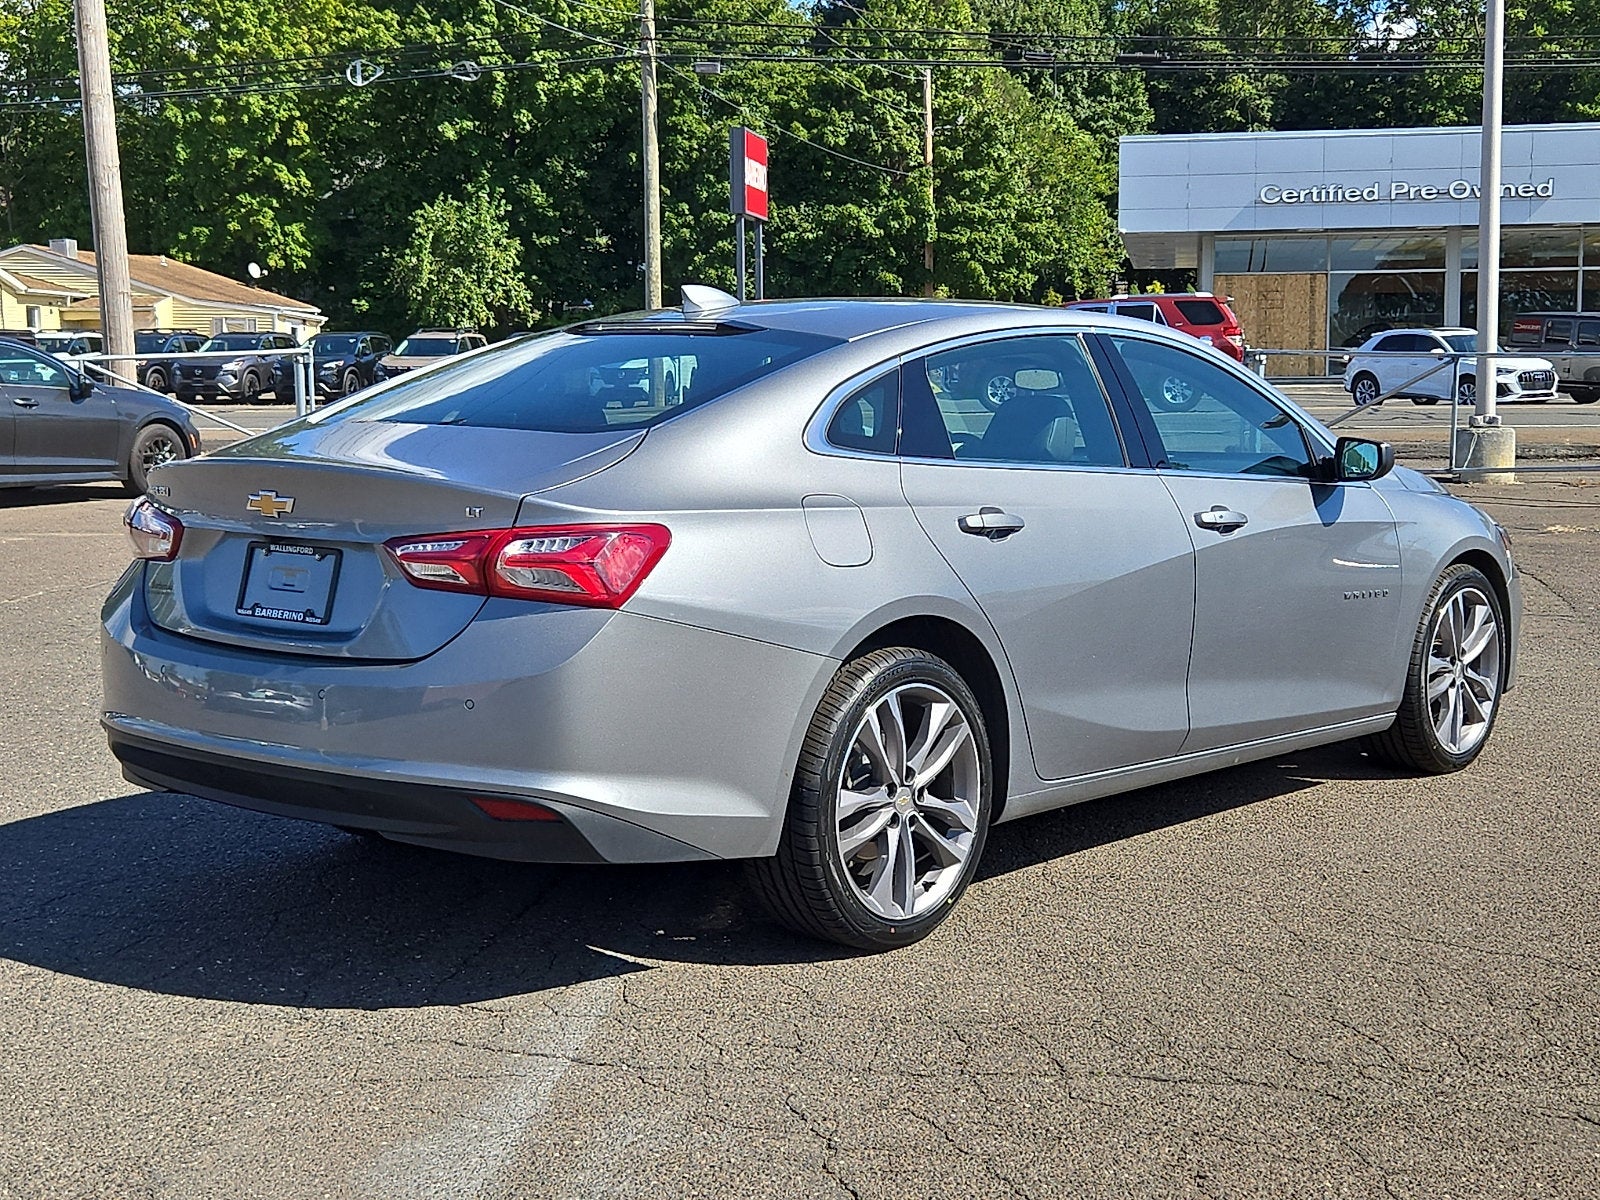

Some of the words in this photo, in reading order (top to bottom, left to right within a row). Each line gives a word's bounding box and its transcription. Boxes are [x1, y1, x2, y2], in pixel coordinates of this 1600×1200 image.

[1259, 181, 1380, 204] Certified
[465, 506, 485, 518] LT
[269, 544, 314, 555] WALLINGFORD
[254, 607, 304, 621] BARBERINO
